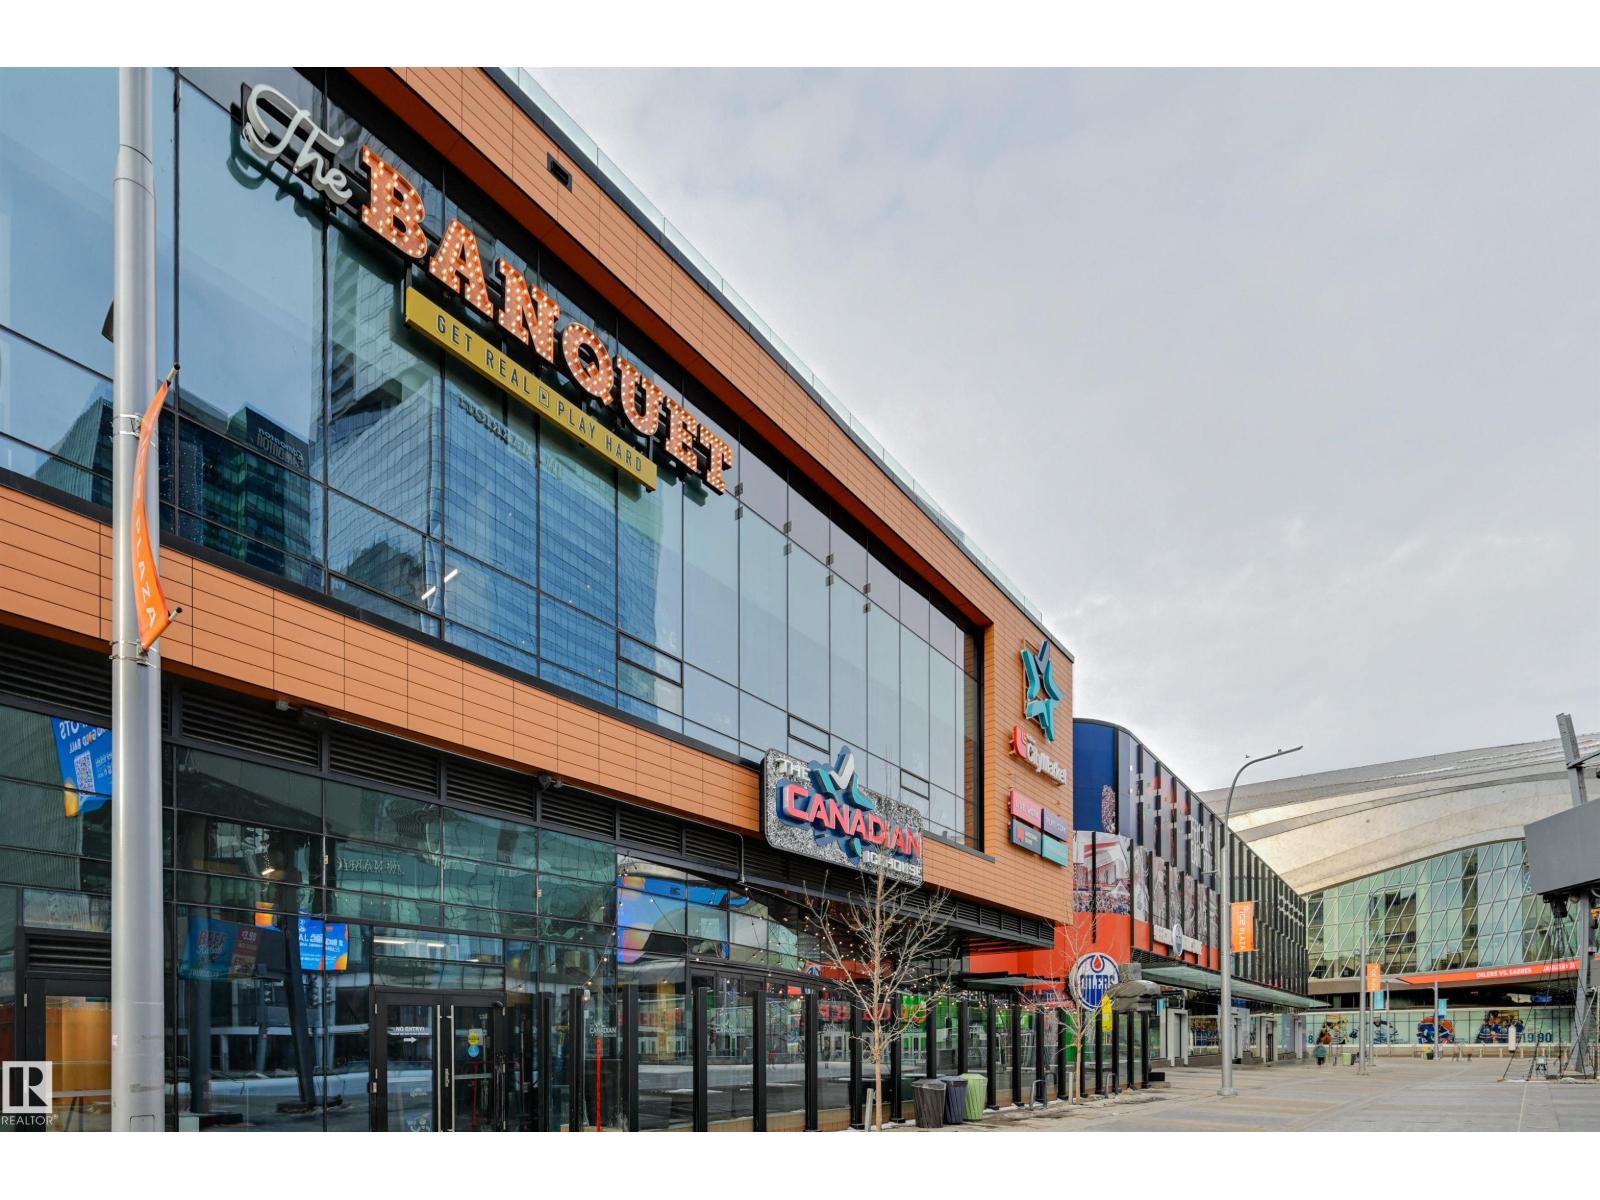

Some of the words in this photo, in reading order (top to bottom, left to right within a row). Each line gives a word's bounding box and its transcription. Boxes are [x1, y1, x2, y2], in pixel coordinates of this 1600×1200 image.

[241, 83, 353, 205] The
[360, 146, 733, 494] BANQUET
[437, 314, 472, 353] GET
[486, 349, 531, 396] REAL
[557, 401, 596, 441] PLAY
[605, 432, 643, 473] HARD
[775, 757, 811, 783] THE
[783, 783, 922, 858] CANADIAN
[1080, 974, 1115, 991] OILERS
